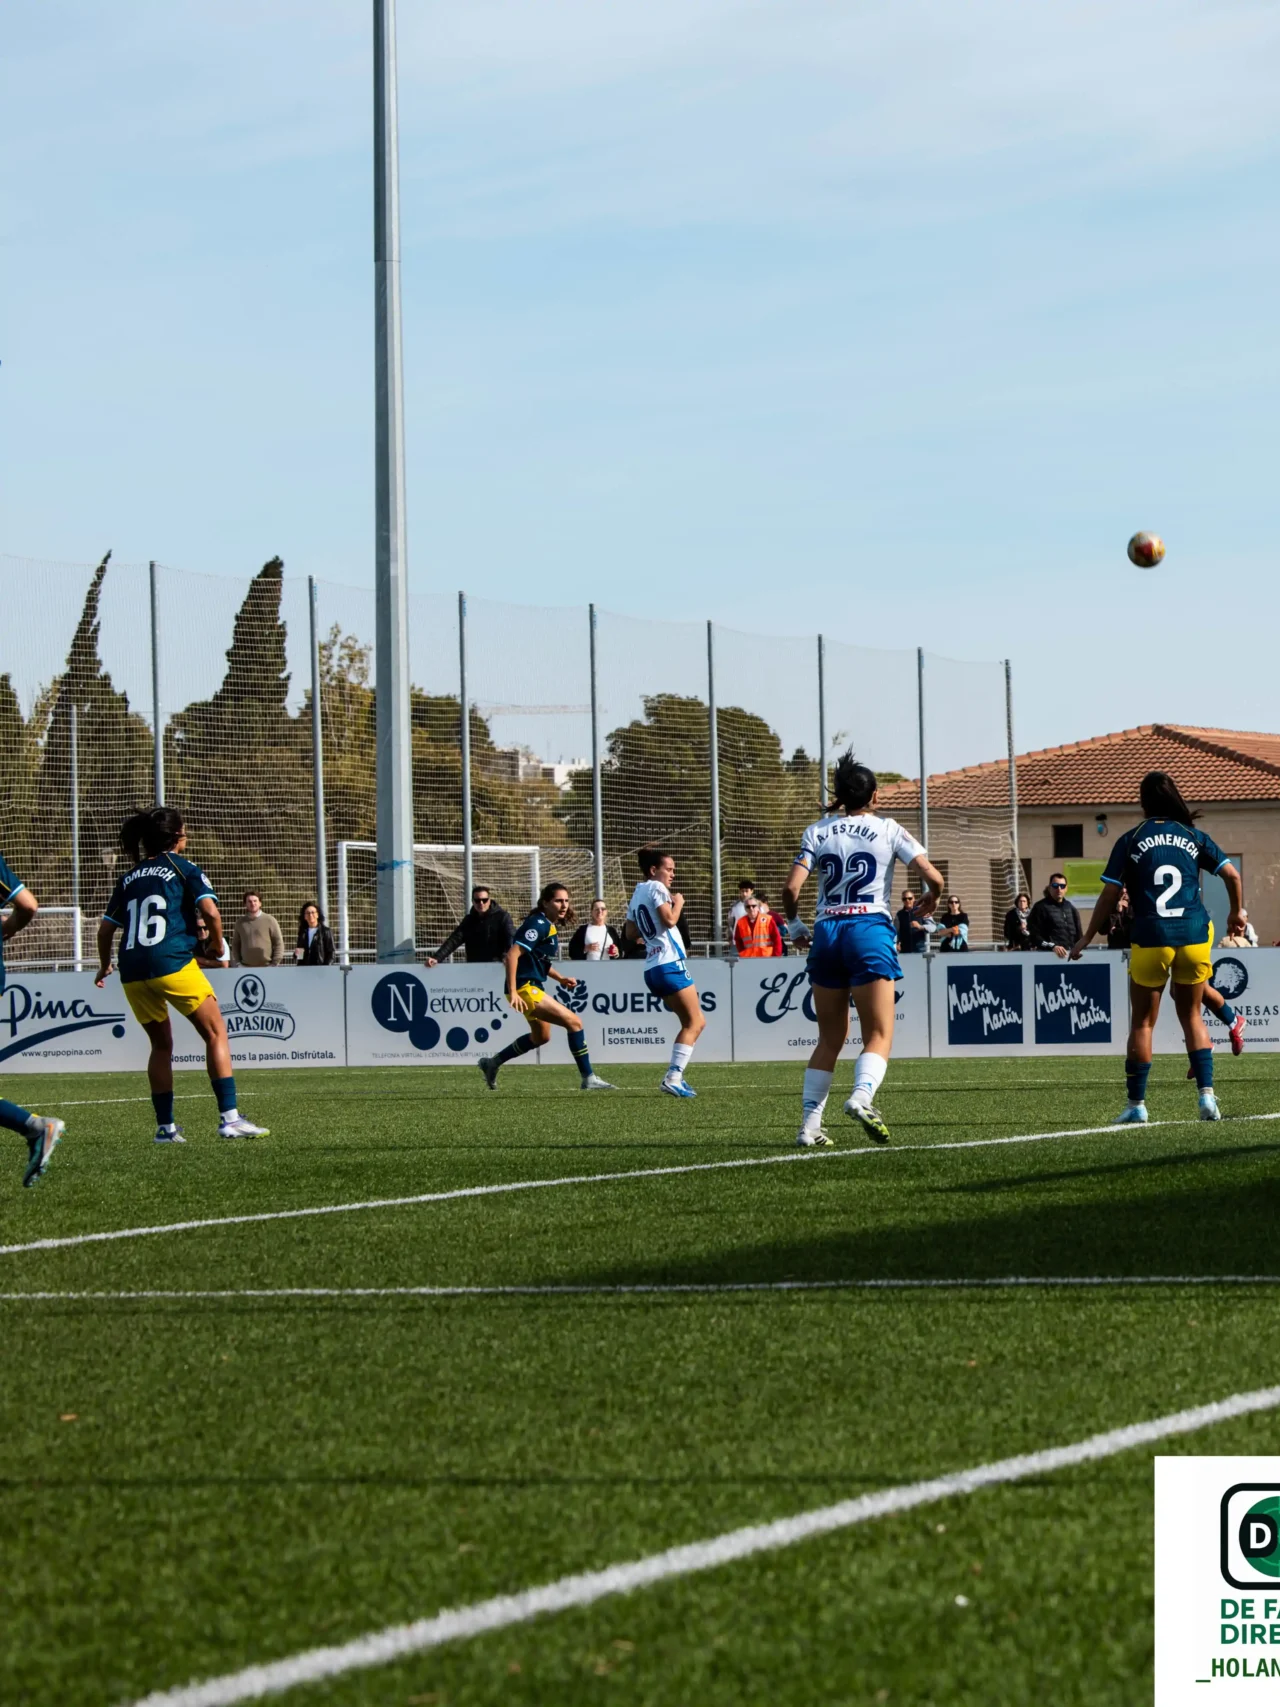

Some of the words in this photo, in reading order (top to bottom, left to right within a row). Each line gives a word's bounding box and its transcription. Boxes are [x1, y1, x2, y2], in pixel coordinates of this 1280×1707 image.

[832, 824, 878, 843] ESTAÚN
[1137, 833, 1200, 860] DOMENECH
[819, 851, 877, 906] 22
[1153, 864, 1185, 918] 2
[126, 894, 167, 951] 16
[0, 984, 125, 1038] Pina
[592, 991, 717, 1015] QUERS
[226, 1015, 284, 1033] APASION
[21, 1049, 102, 1057] www.grupopina.com
[608, 1037, 665, 1045] SOSTENIBLES
[248, 1052, 256, 1061] la
